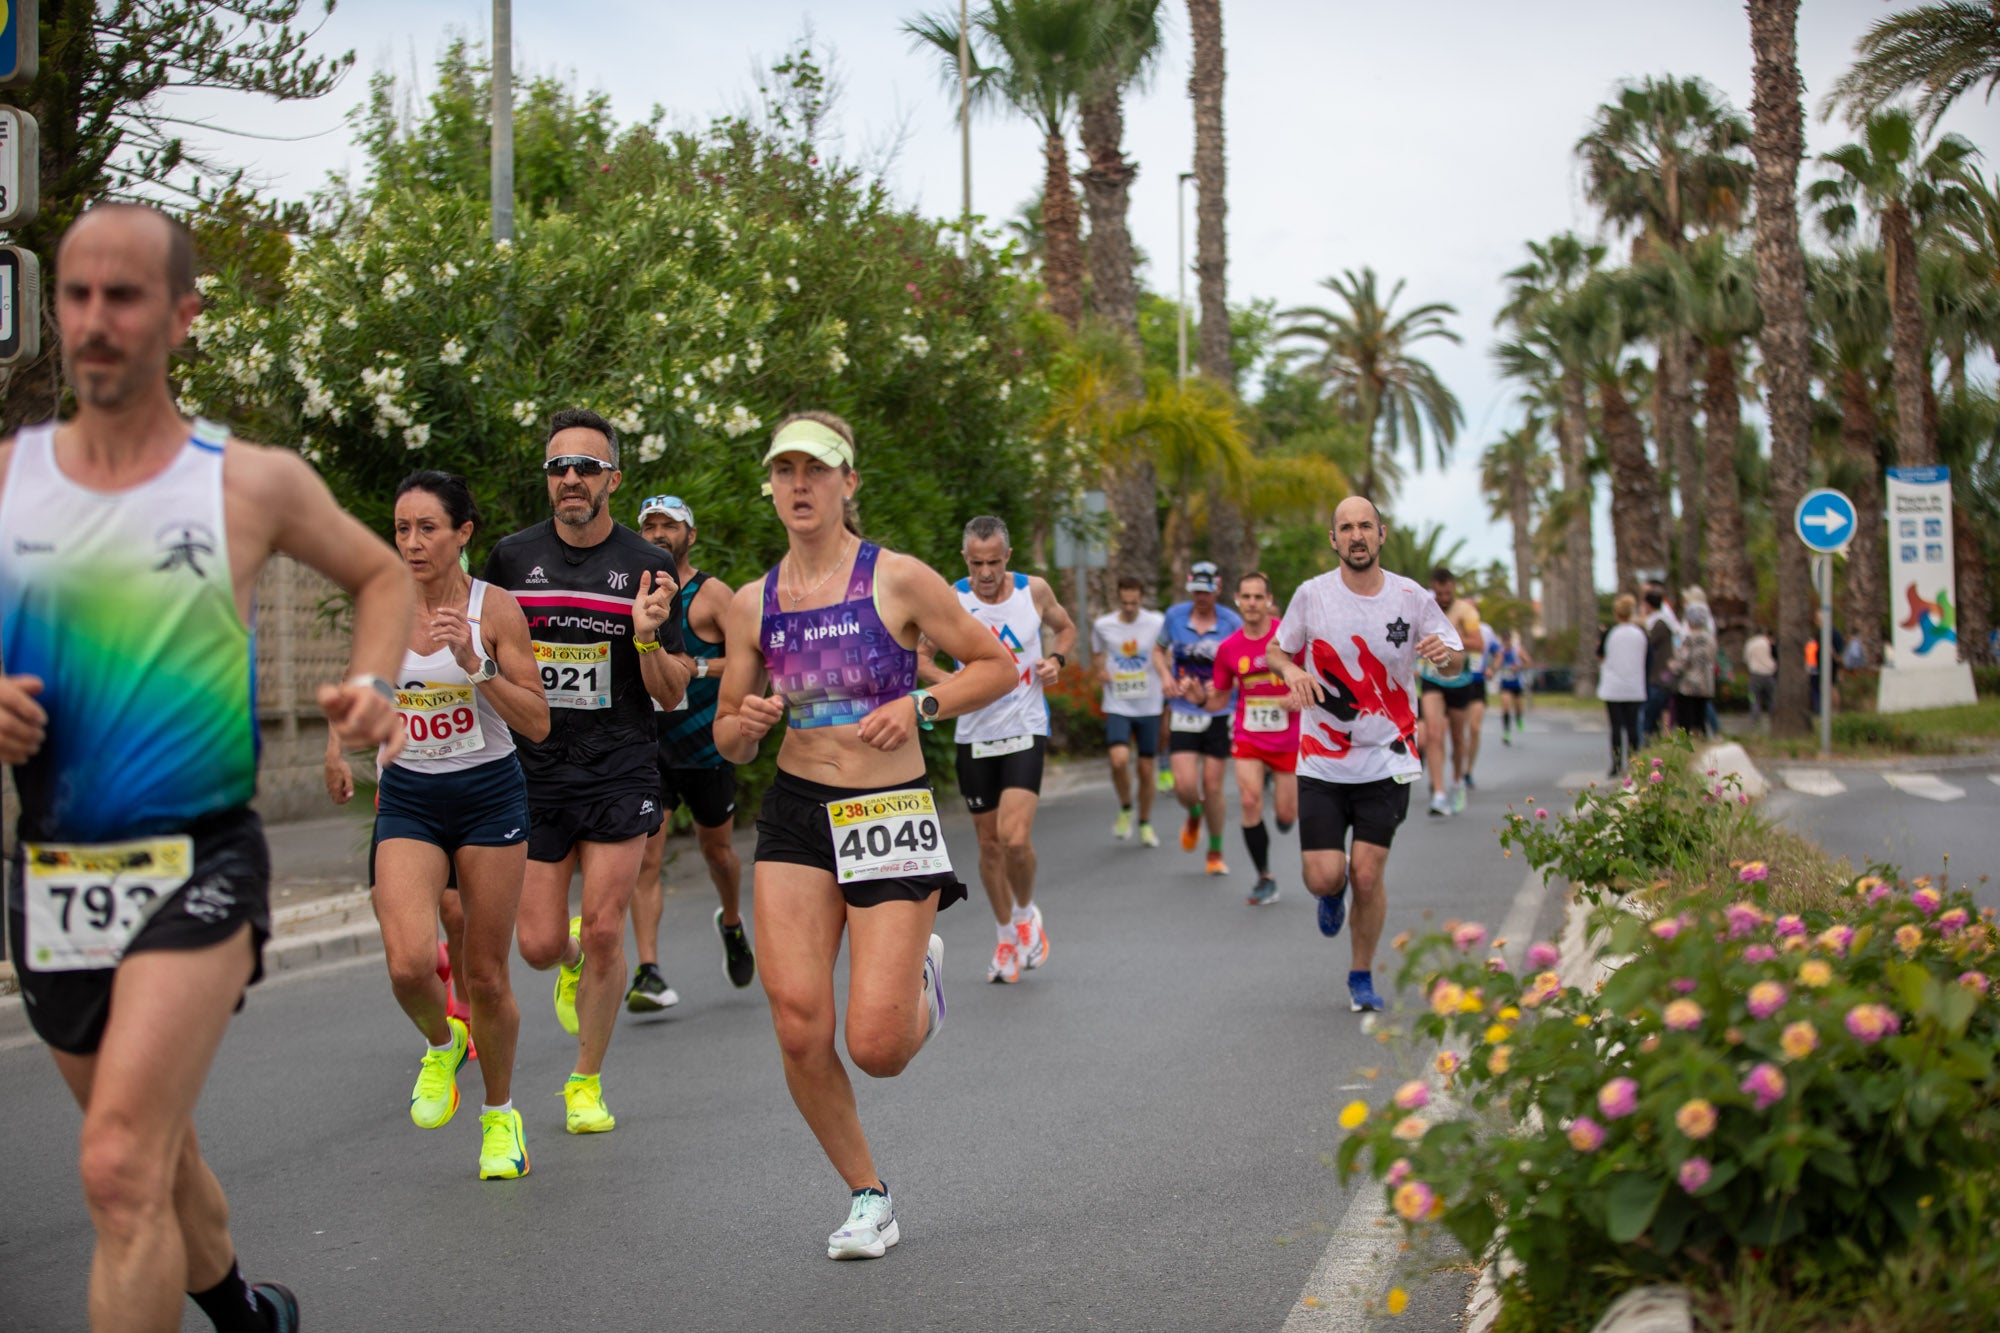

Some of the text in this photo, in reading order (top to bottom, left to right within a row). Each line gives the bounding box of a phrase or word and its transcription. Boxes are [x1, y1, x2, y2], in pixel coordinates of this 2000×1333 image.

[804, 622, 860, 641] KIPRUN
[541, 646, 552, 658] 38
[552, 650, 597, 660] FONDO
[541, 666, 597, 692] 921
[1252, 709, 1280, 723] 178
[845, 803, 864, 818] 38
[864, 799, 920, 817] FONDO
[839, 820, 938, 860] 4049
